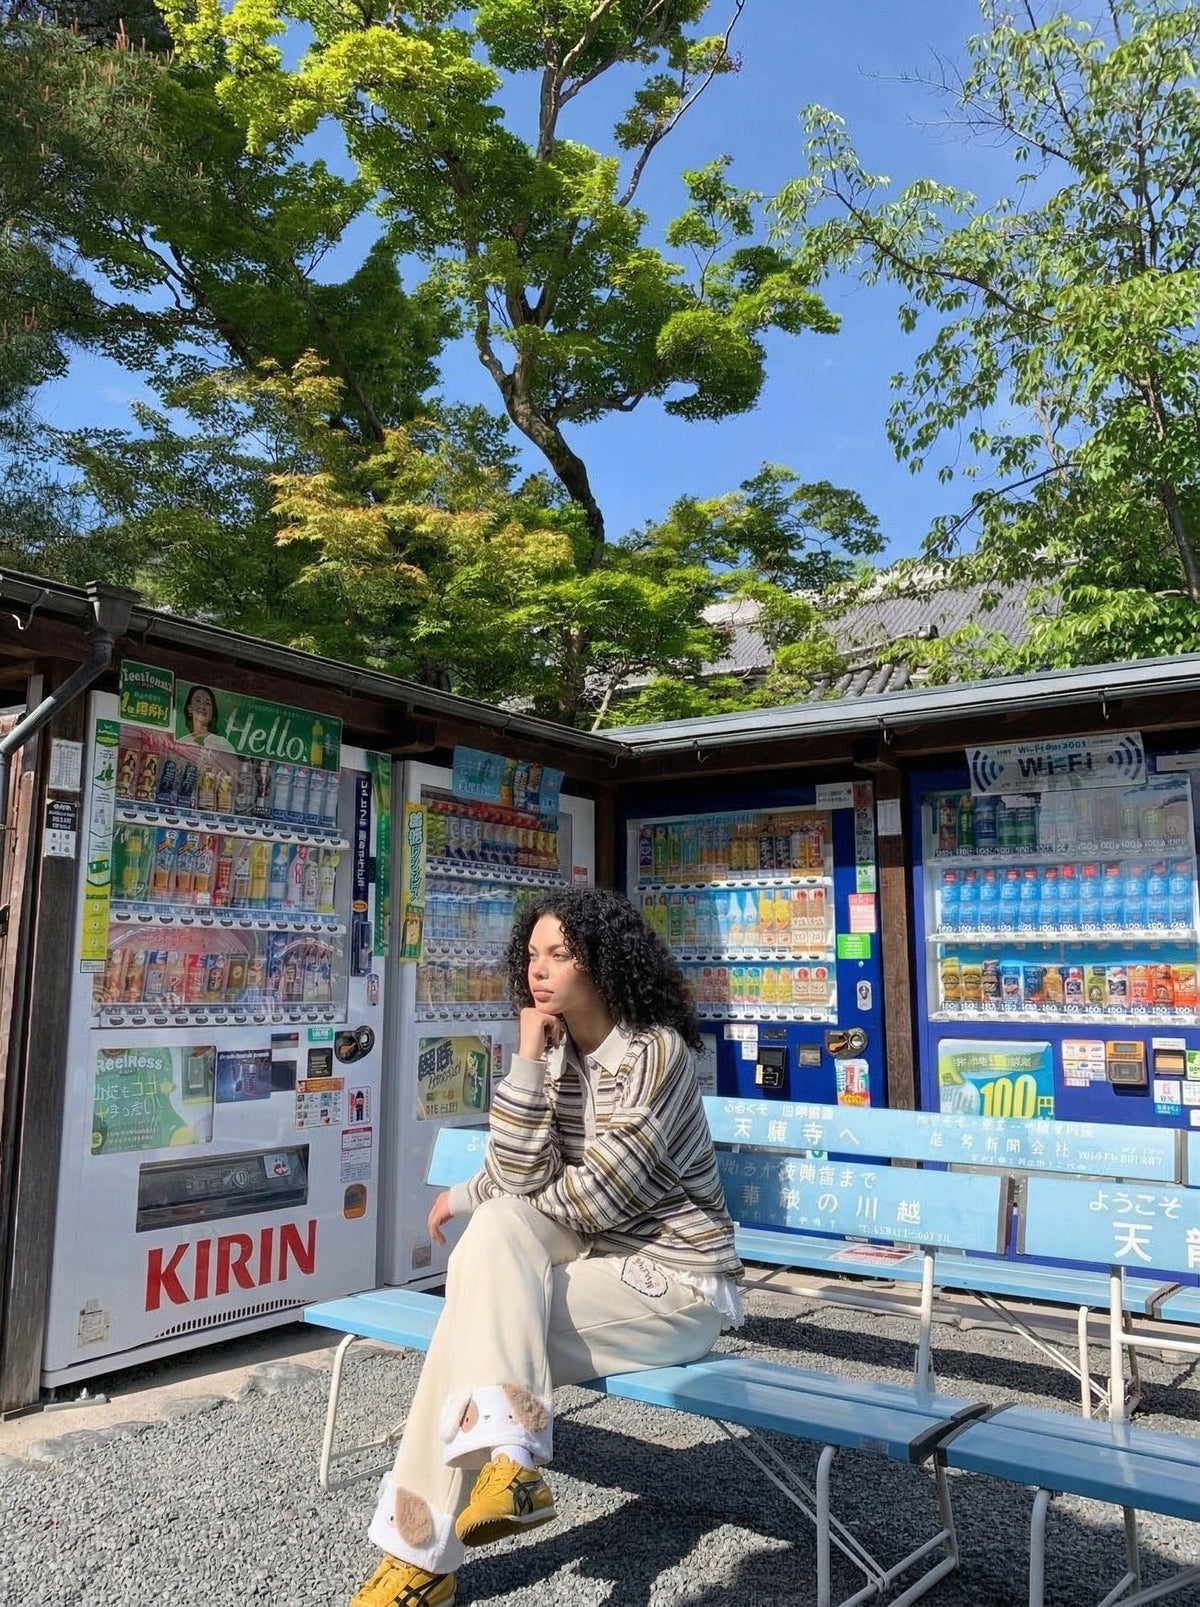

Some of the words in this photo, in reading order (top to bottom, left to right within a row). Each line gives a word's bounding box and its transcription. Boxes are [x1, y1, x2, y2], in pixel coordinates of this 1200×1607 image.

[1017, 752, 1093, 778] Wi-Fi
[1089, 1190, 1182, 1219] ようこそ
[144, 1219, 318, 1312] KIRIN
